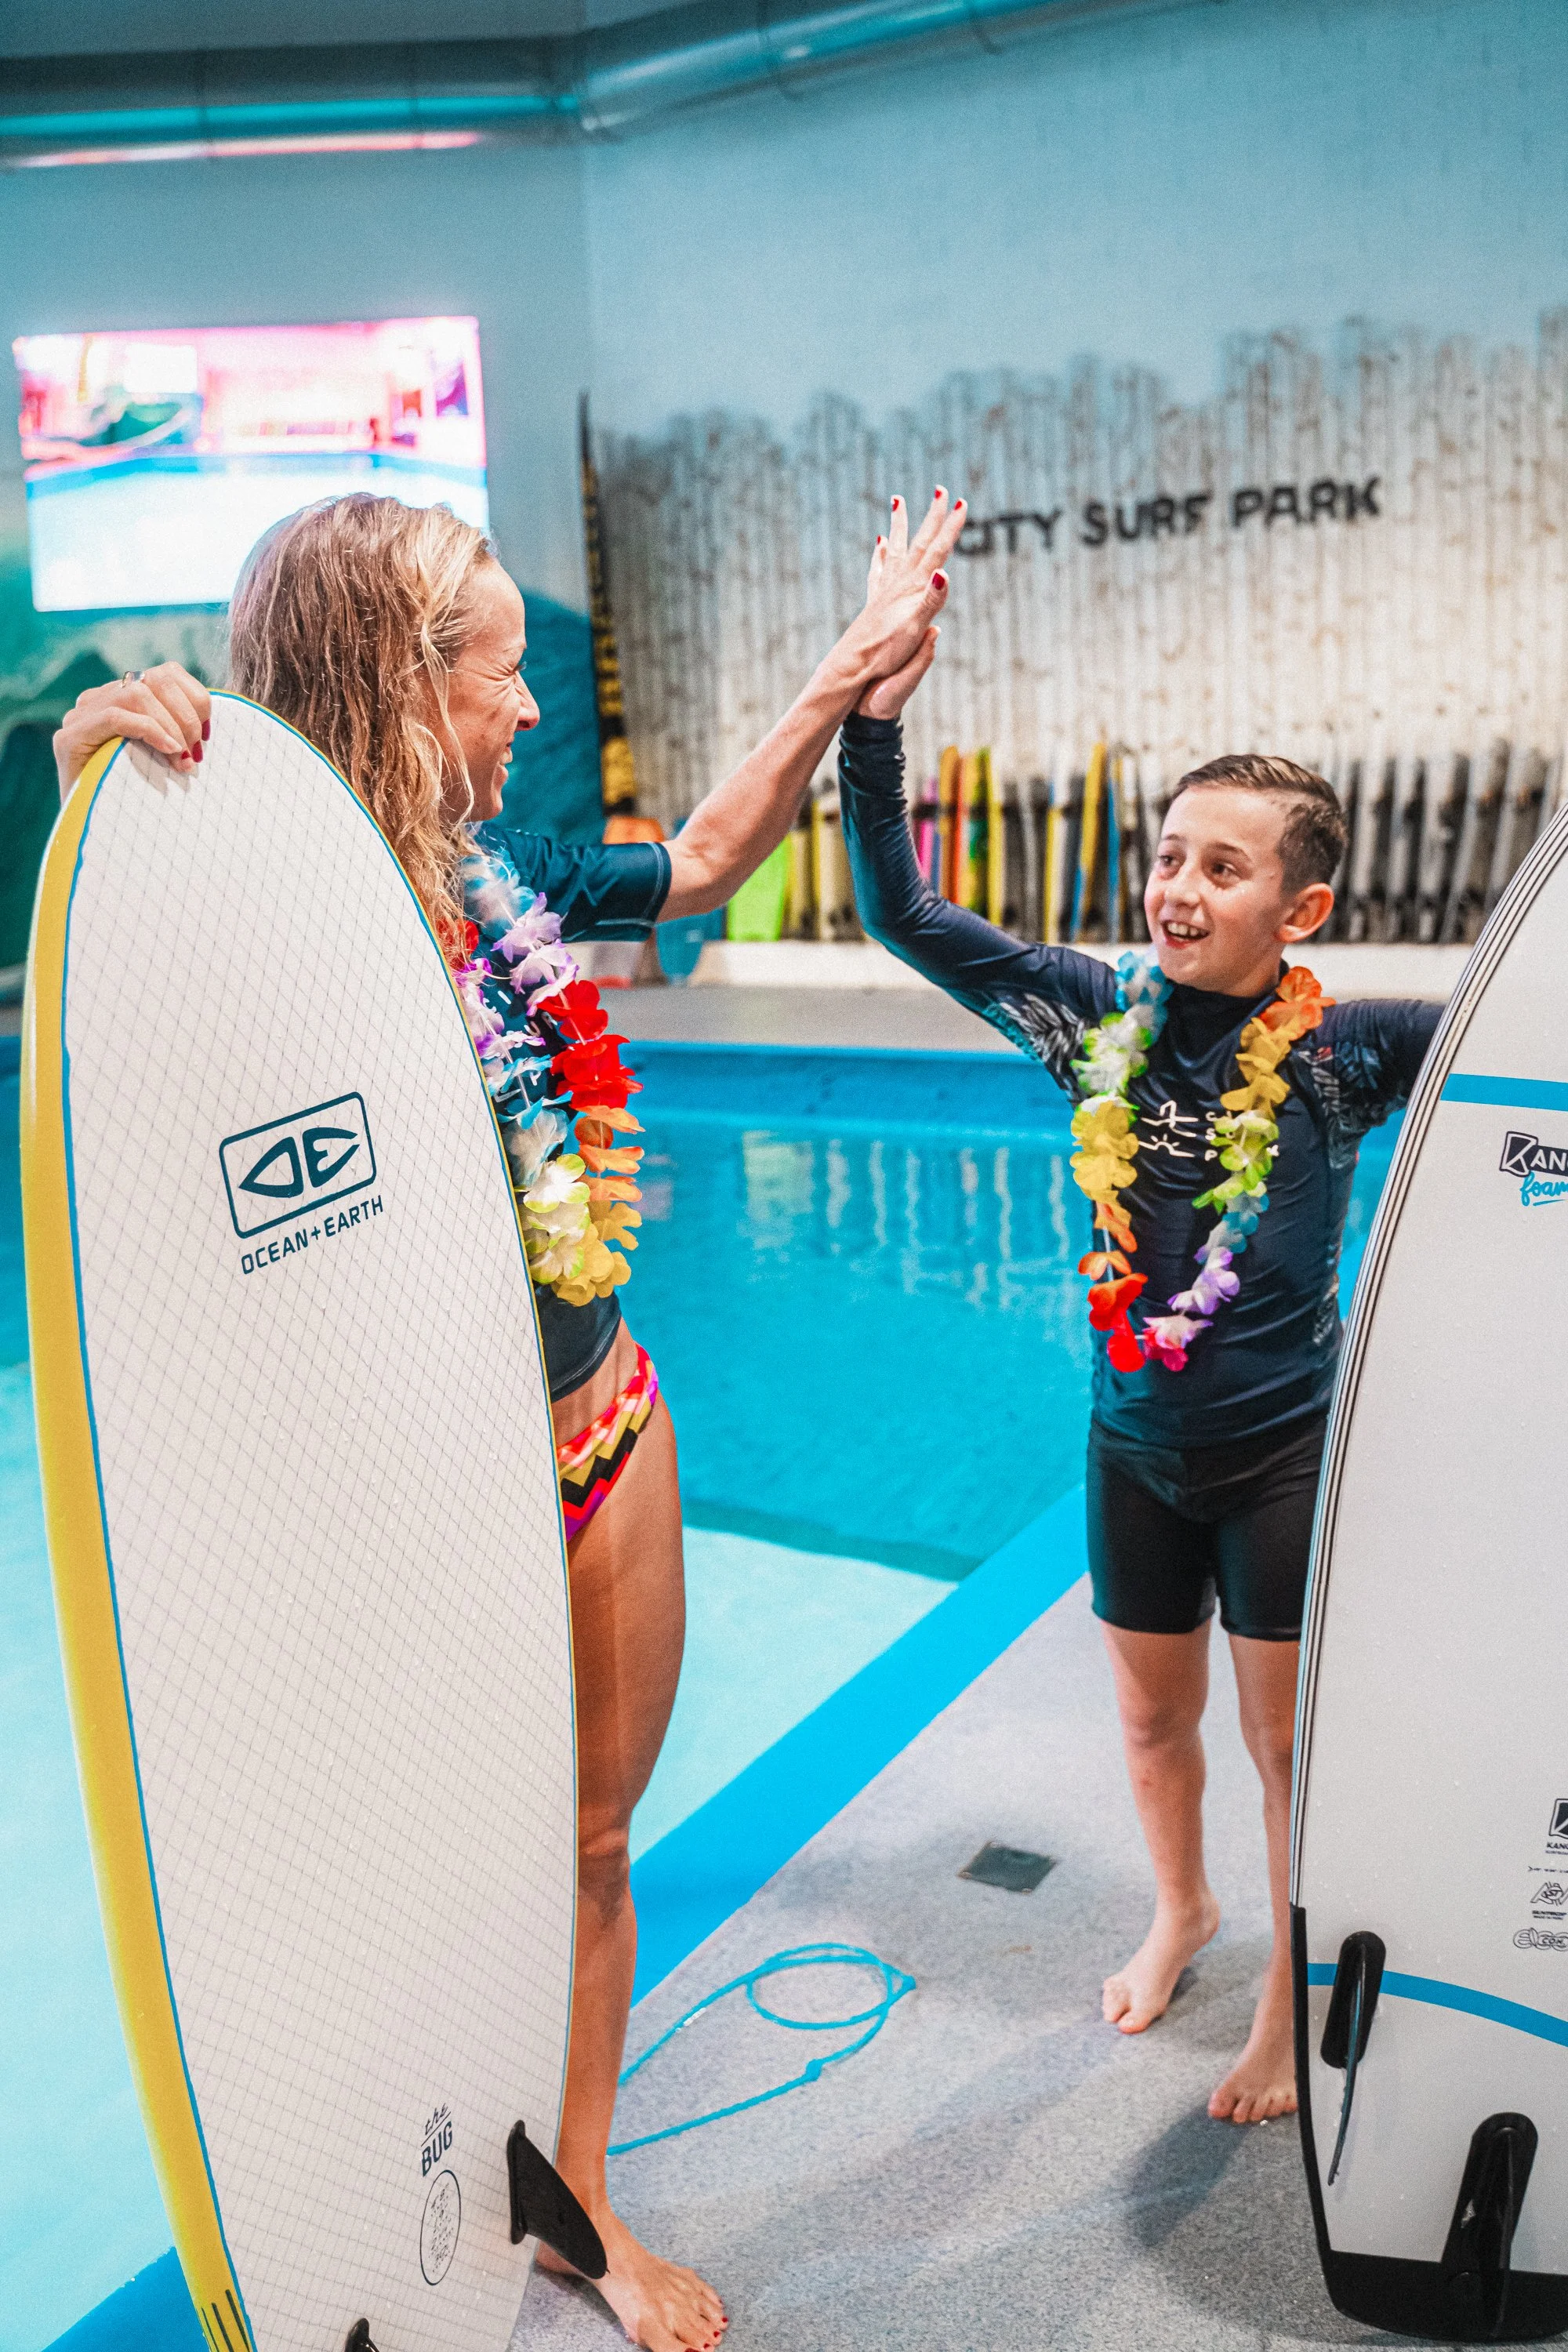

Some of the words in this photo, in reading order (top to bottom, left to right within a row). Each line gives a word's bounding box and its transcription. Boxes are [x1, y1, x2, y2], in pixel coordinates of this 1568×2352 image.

[956, 506, 1063, 557] CITY
[1080, 492, 1212, 547] SURF
[1230, 474, 1382, 531] PARK
[1500, 1132, 1568, 1177] KAN
[241, 1195, 384, 1276] OCEAN+EARTH
[424, 2103, 449, 2136] the
[421, 2121, 453, 2178] BUG
